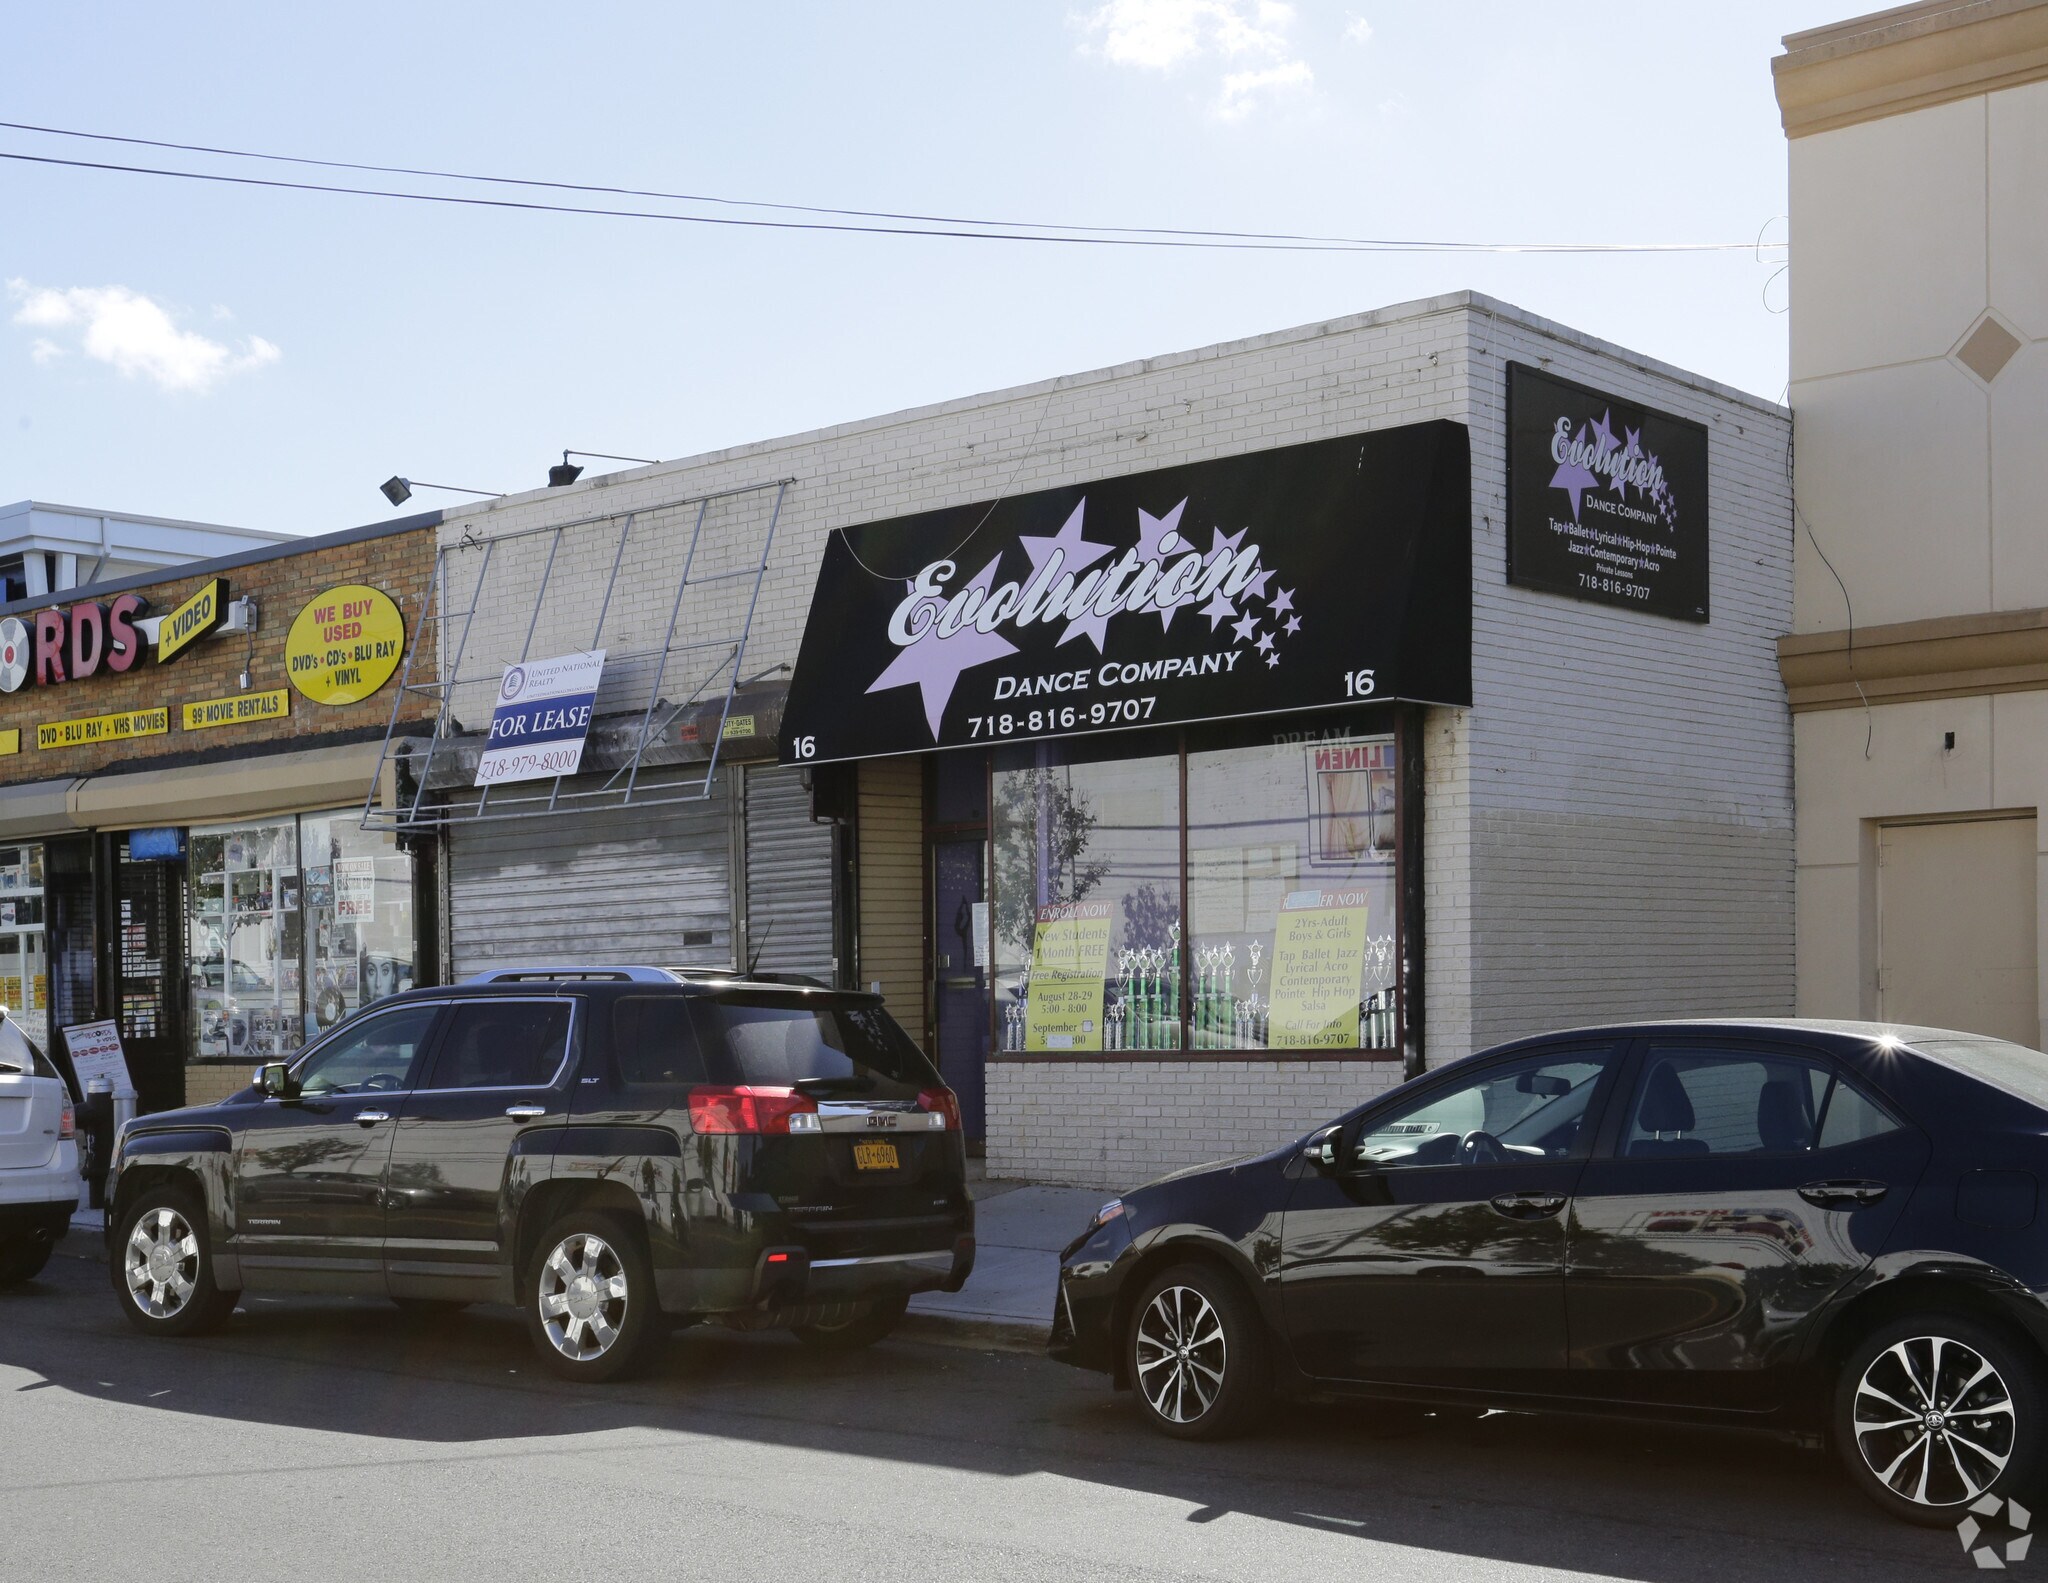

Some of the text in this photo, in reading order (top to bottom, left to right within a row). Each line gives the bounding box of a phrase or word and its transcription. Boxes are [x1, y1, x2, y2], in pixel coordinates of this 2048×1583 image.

[1552, 416, 1664, 490] Evolution
[1586, 494, 1658, 525] DANCE COMPANY
[1549, 518, 1677, 559] Tap Ballet Lyrical Hip-Hop Pointe
[1568, 540, 1660, 572] Jazz Contemporary Acro
[1596, 563, 1633, 579] Private Lessons
[887, 530, 1260, 646] Evolution
[1578, 573, 1650, 600] 718-816-9707
[172, 594, 211, 641] VIDEO
[314, 599, 373, 624] WE BUY
[323, 622, 362, 643] USED
[292, 640, 396, 672] DVD's CD's BLU RAY
[335, 667, 362, 686] VINYL
[531, 660, 601, 678] UNITED NATIONAL
[994, 650, 1243, 701] DANCE COMPANY
[528, 676, 555, 688] REALTY
[1345, 669, 1374, 697] 16
[206, 702, 234, 722] MOVIE
[237, 695, 278, 718] RENTALS
[967, 696, 1156, 739] 718-816-9707
[40, 728, 57, 745] DVD
[65, 725, 82, 741] BLU
[86, 721, 102, 738] RAY
[113, 717, 130, 734] VHS
[133, 712, 165, 732] MOVIES
[488, 705, 591, 740] FOR LEASE
[793, 736, 816, 759] 16
[1273, 726, 1351, 753] DREAM
[481, 749, 577, 779] 718-979-8000
[338, 900, 371, 915] FREE
[1335, 891, 1368, 906] NOW
[1040, 903, 1110, 920] ENROLL NOW
[1036, 927, 1108, 942] New Students
[1289, 927, 1351, 942] Boys & Girls
[1042, 946, 1074, 959] Month
[1078, 944, 1104, 957] FREE
[1279, 948, 1358, 963] Tap Ballet Jazz
[1031, 968, 1103, 982] Free Registration
[1286, 961, 1348, 974] Lyrical Acro
[1279, 975, 1352, 988] Contemporary
[1038, 991, 1092, 1005] August 28-29
[1275, 986, 1355, 999] Pointe Hip Hop
[1041, 1004, 1060, 1015] 5:00
[1068, 1003, 1087, 1014] 8:00
[1301, 1001, 1326, 1011] Salsa
[1033, 1022, 1077, 1036] September
[1285, 1019, 1342, 1031] Call For Info
[1276, 1033, 1350, 1046] 718-816-9707
[866, 1114, 897, 1127] GMC
